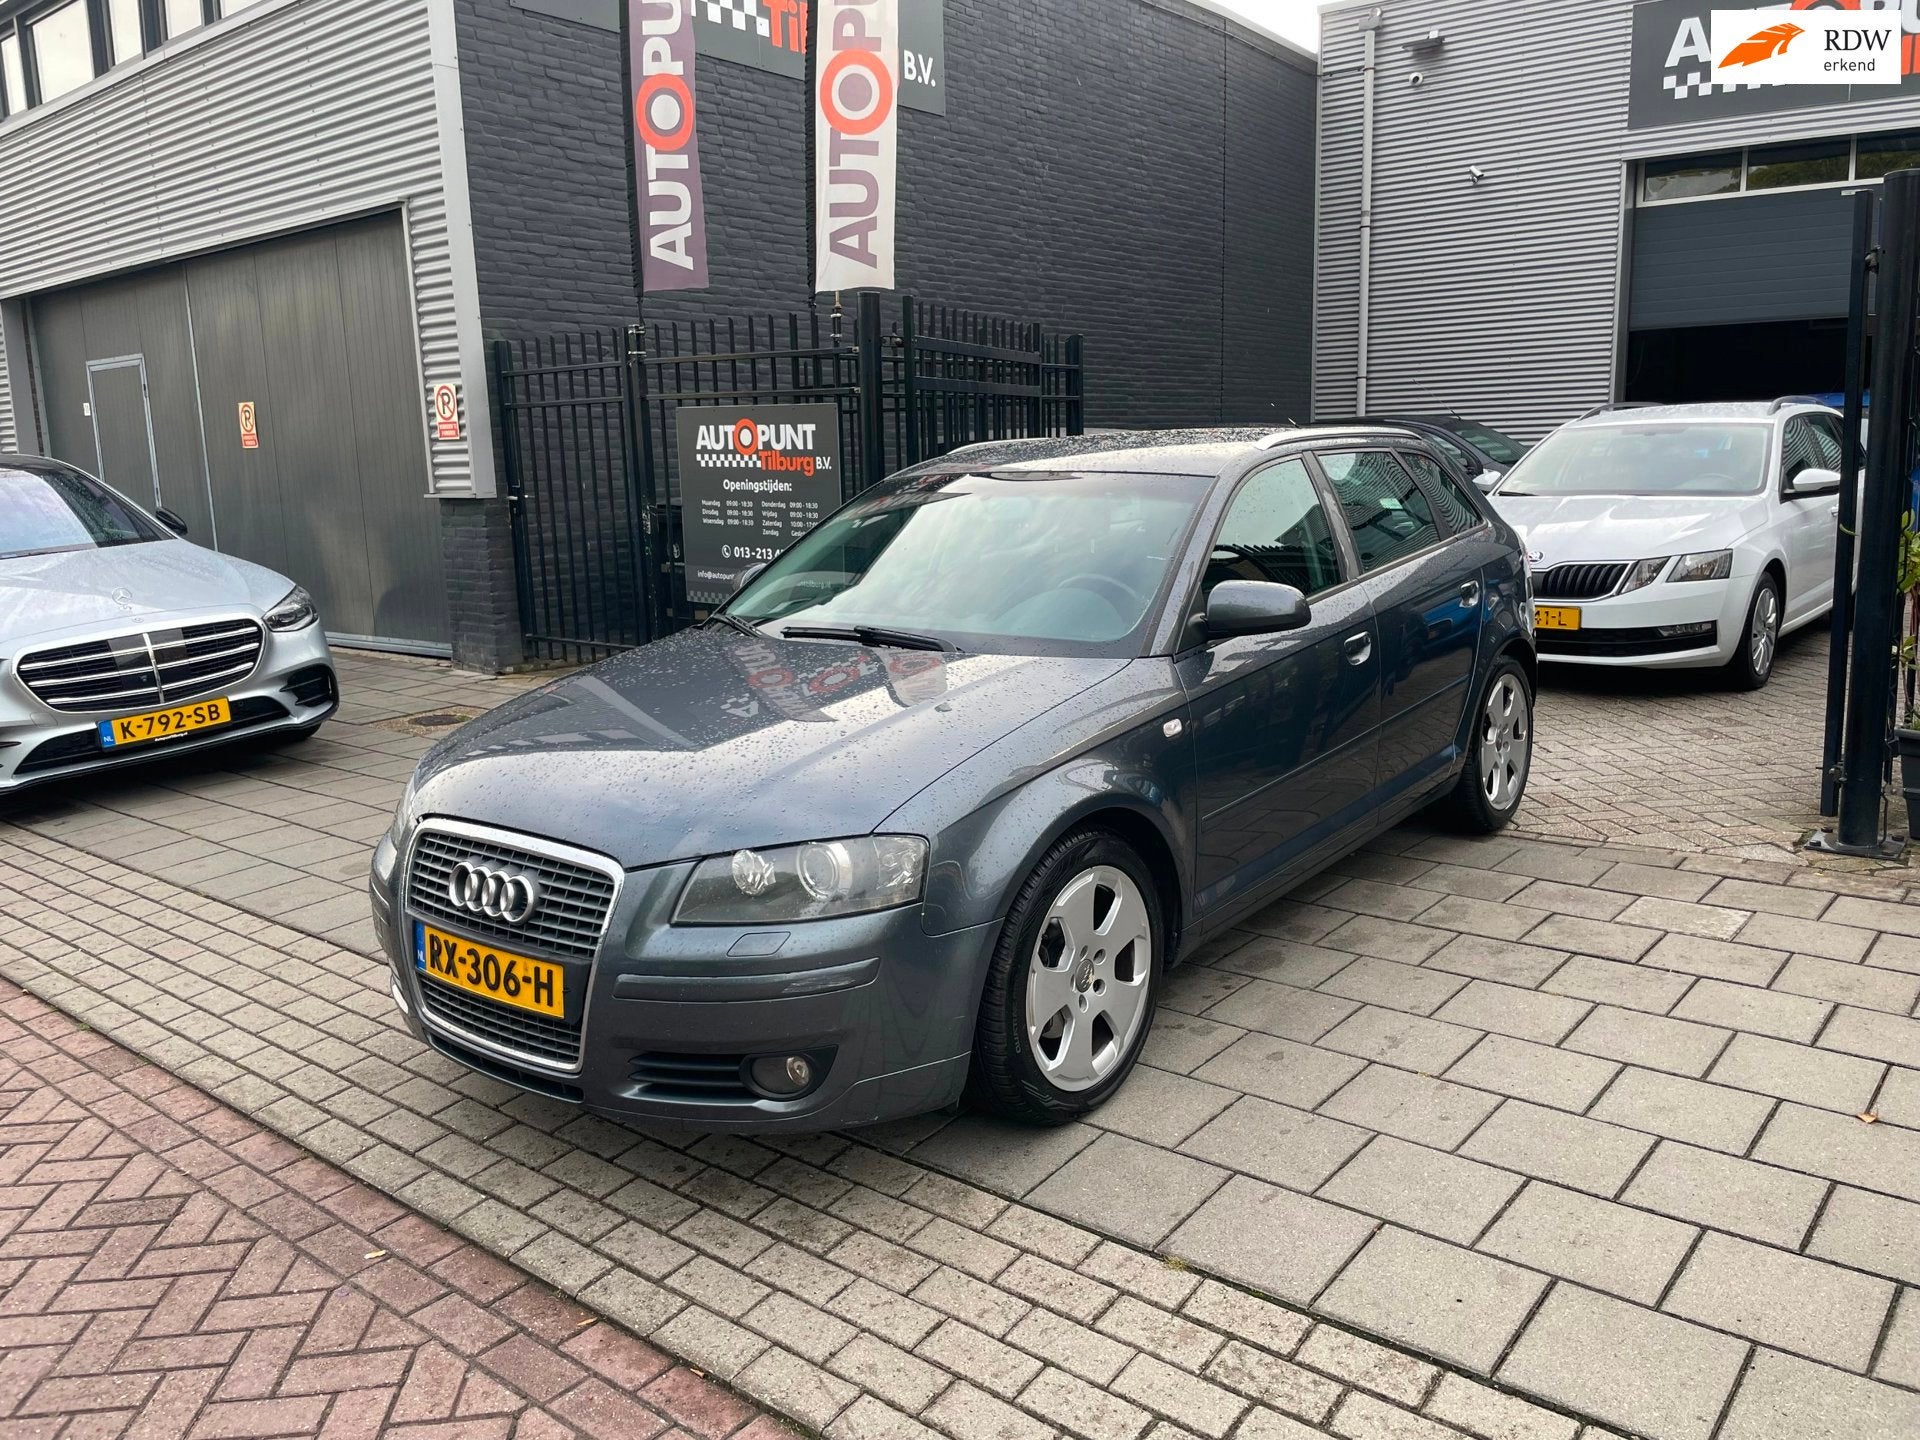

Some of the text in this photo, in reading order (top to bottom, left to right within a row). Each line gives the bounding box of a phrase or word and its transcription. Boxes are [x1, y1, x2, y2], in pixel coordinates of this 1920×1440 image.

[903, 50, 936, 87] B.V.
[820, 0, 893, 269] AUTOP
[696, 418, 816, 456] AUTOPUNT
[759, 450, 832, 477] Tilburg B.V.
[723, 478, 792, 493] Openingstijden:
[761, 510, 778, 519] Vrijdag
[103, 735, 114, 743] NL
[120, 703, 221, 739] K-792-SB
[429, 934, 553, 1007] RX-306-H
